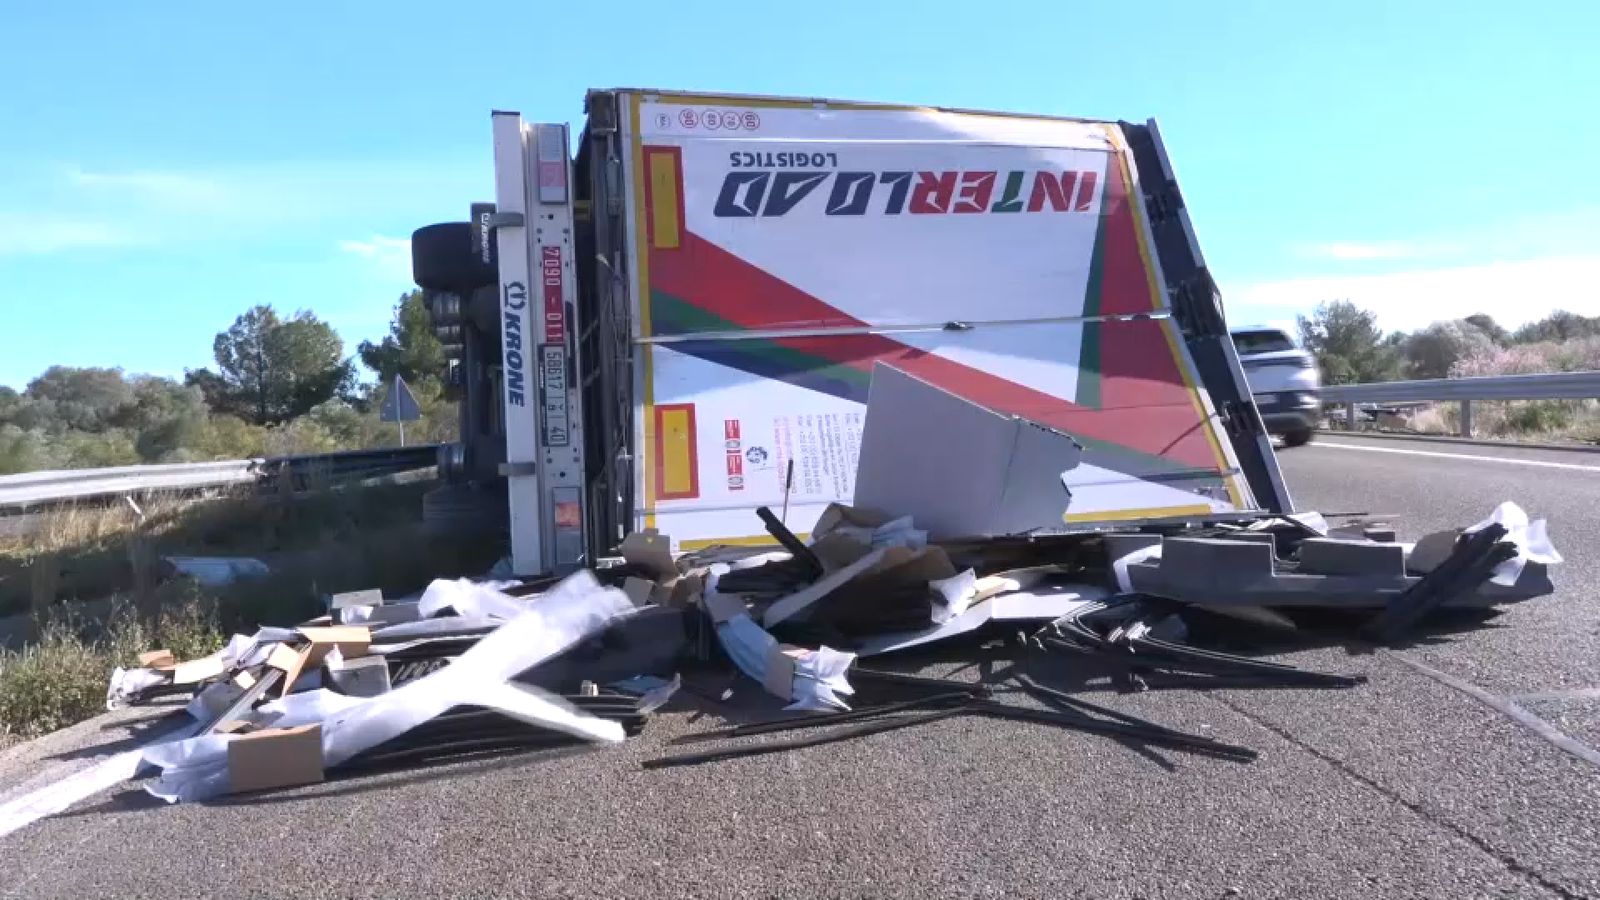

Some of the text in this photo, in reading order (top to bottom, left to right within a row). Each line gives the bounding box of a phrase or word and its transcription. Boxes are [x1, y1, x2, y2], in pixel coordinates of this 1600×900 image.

[729, 152, 838, 167] LOGISTICS
[713, 171, 1098, 217] INTERLOAD
[544, 248, 561, 286] 7090
[546, 312, 563, 338] 011
[504, 312, 525, 408] KRONE
[546, 351, 563, 390] 58617
[550, 426, 566, 441] 40
